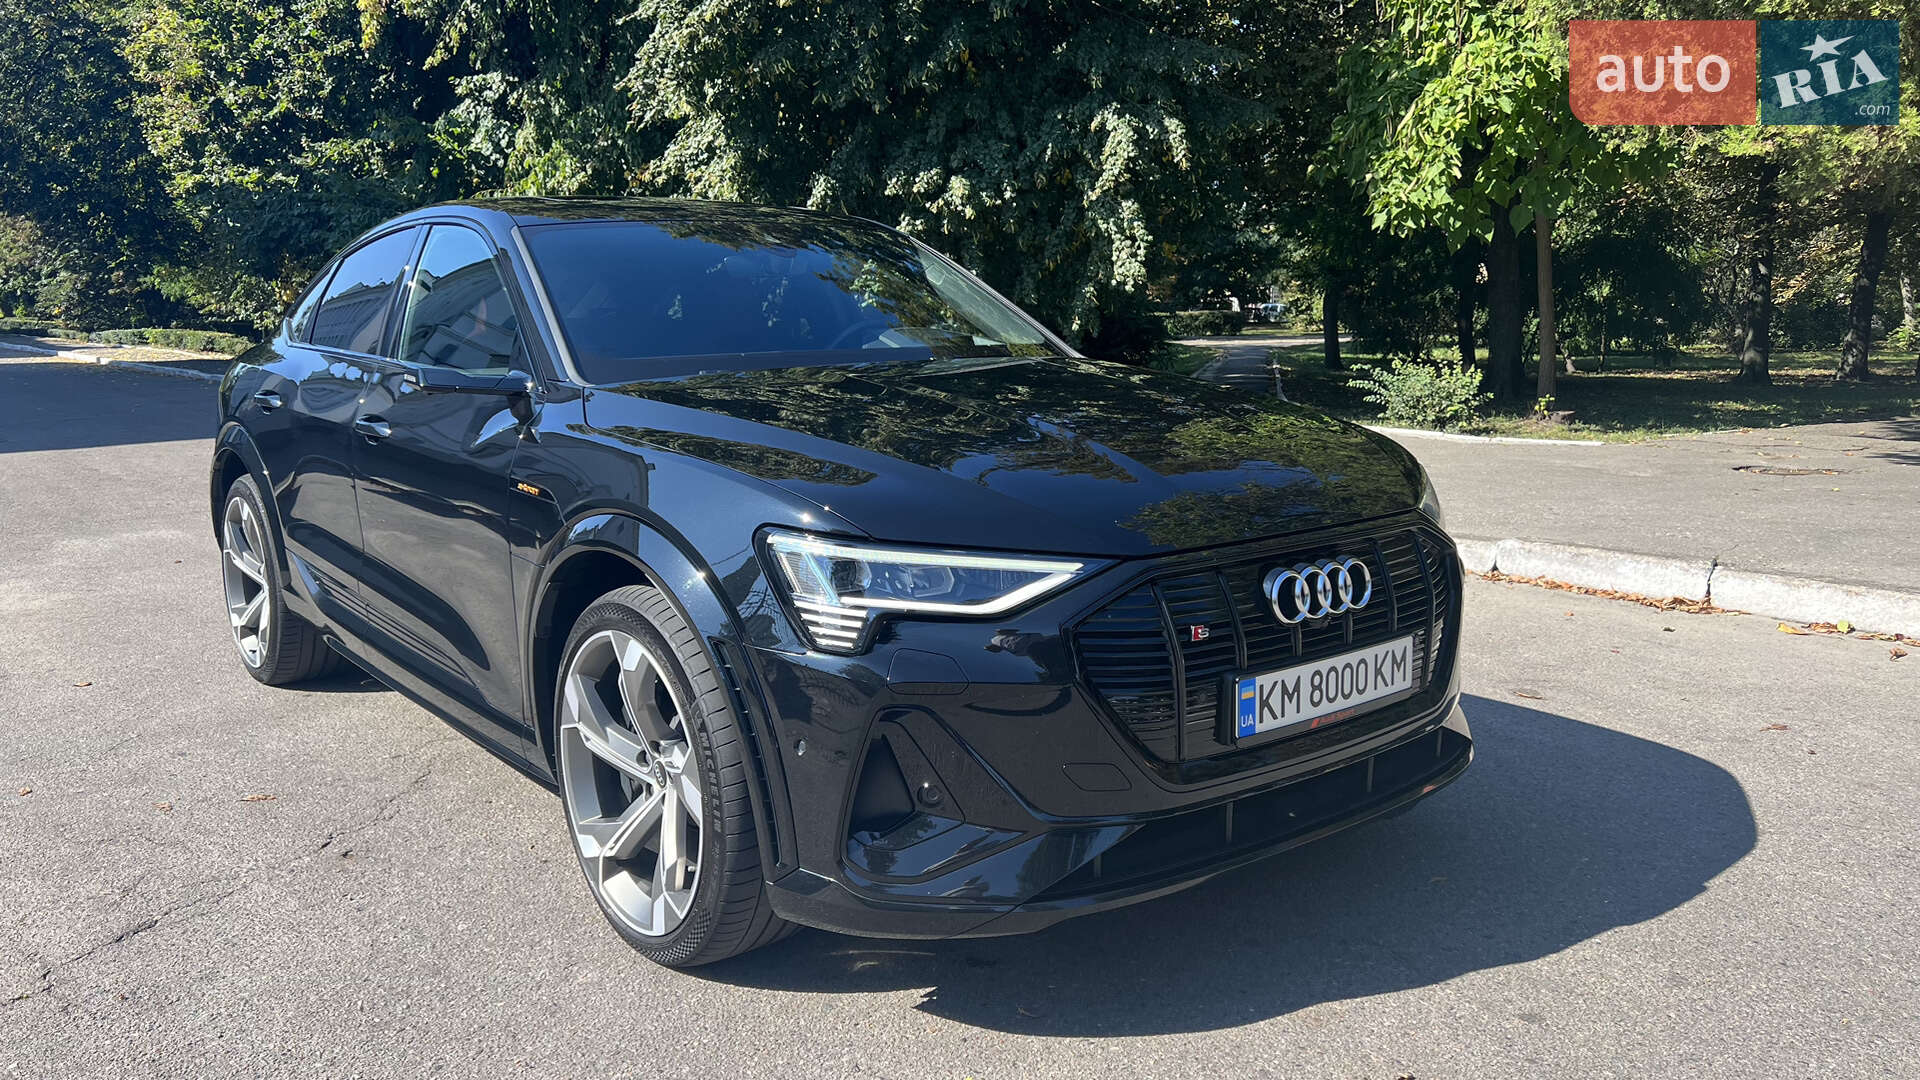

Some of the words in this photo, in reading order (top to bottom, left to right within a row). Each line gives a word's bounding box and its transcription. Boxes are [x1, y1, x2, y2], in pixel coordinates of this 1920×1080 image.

[1241, 714, 1255, 728] UA
[1259, 675, 1300, 724] KM
[1309, 657, 1368, 708] 8000
[1374, 646, 1407, 691] KM
[701, 731, 723, 833] MICHELIN
